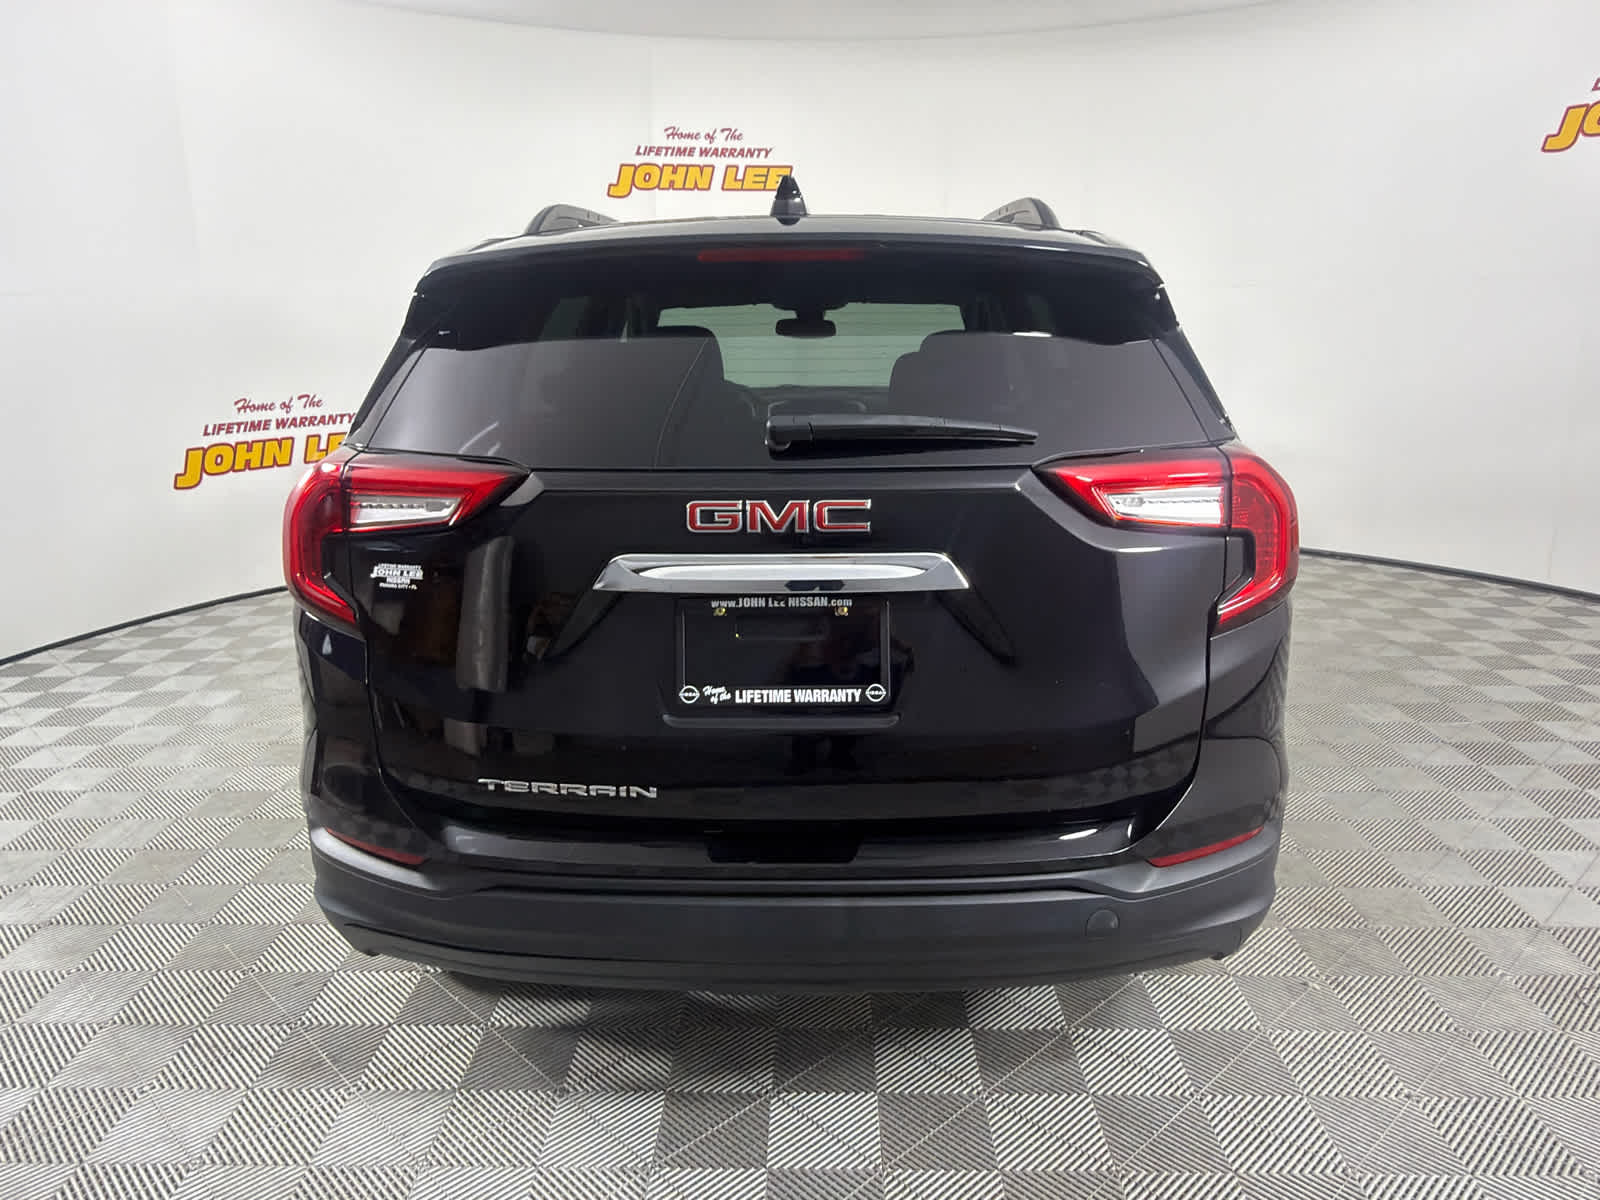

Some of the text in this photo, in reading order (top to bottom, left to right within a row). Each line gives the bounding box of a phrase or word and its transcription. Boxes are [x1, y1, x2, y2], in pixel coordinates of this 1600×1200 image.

[664, 126, 744, 145] Home of The
[635, 145, 773, 158] LIFETIME WARRANTY
[607, 163, 793, 198] JOHN LEE
[234, 394, 323, 414] Home of The
[203, 412, 356, 437] LIFETIME WARRANTY
[174, 431, 348, 489] JOHN LE
[686, 499, 872, 533] GMC
[370, 566, 424, 580] JOHN LEE
[735, 688, 862, 703] LIFETIME WARRANTY
[478, 778, 657, 798] TERRAIN
